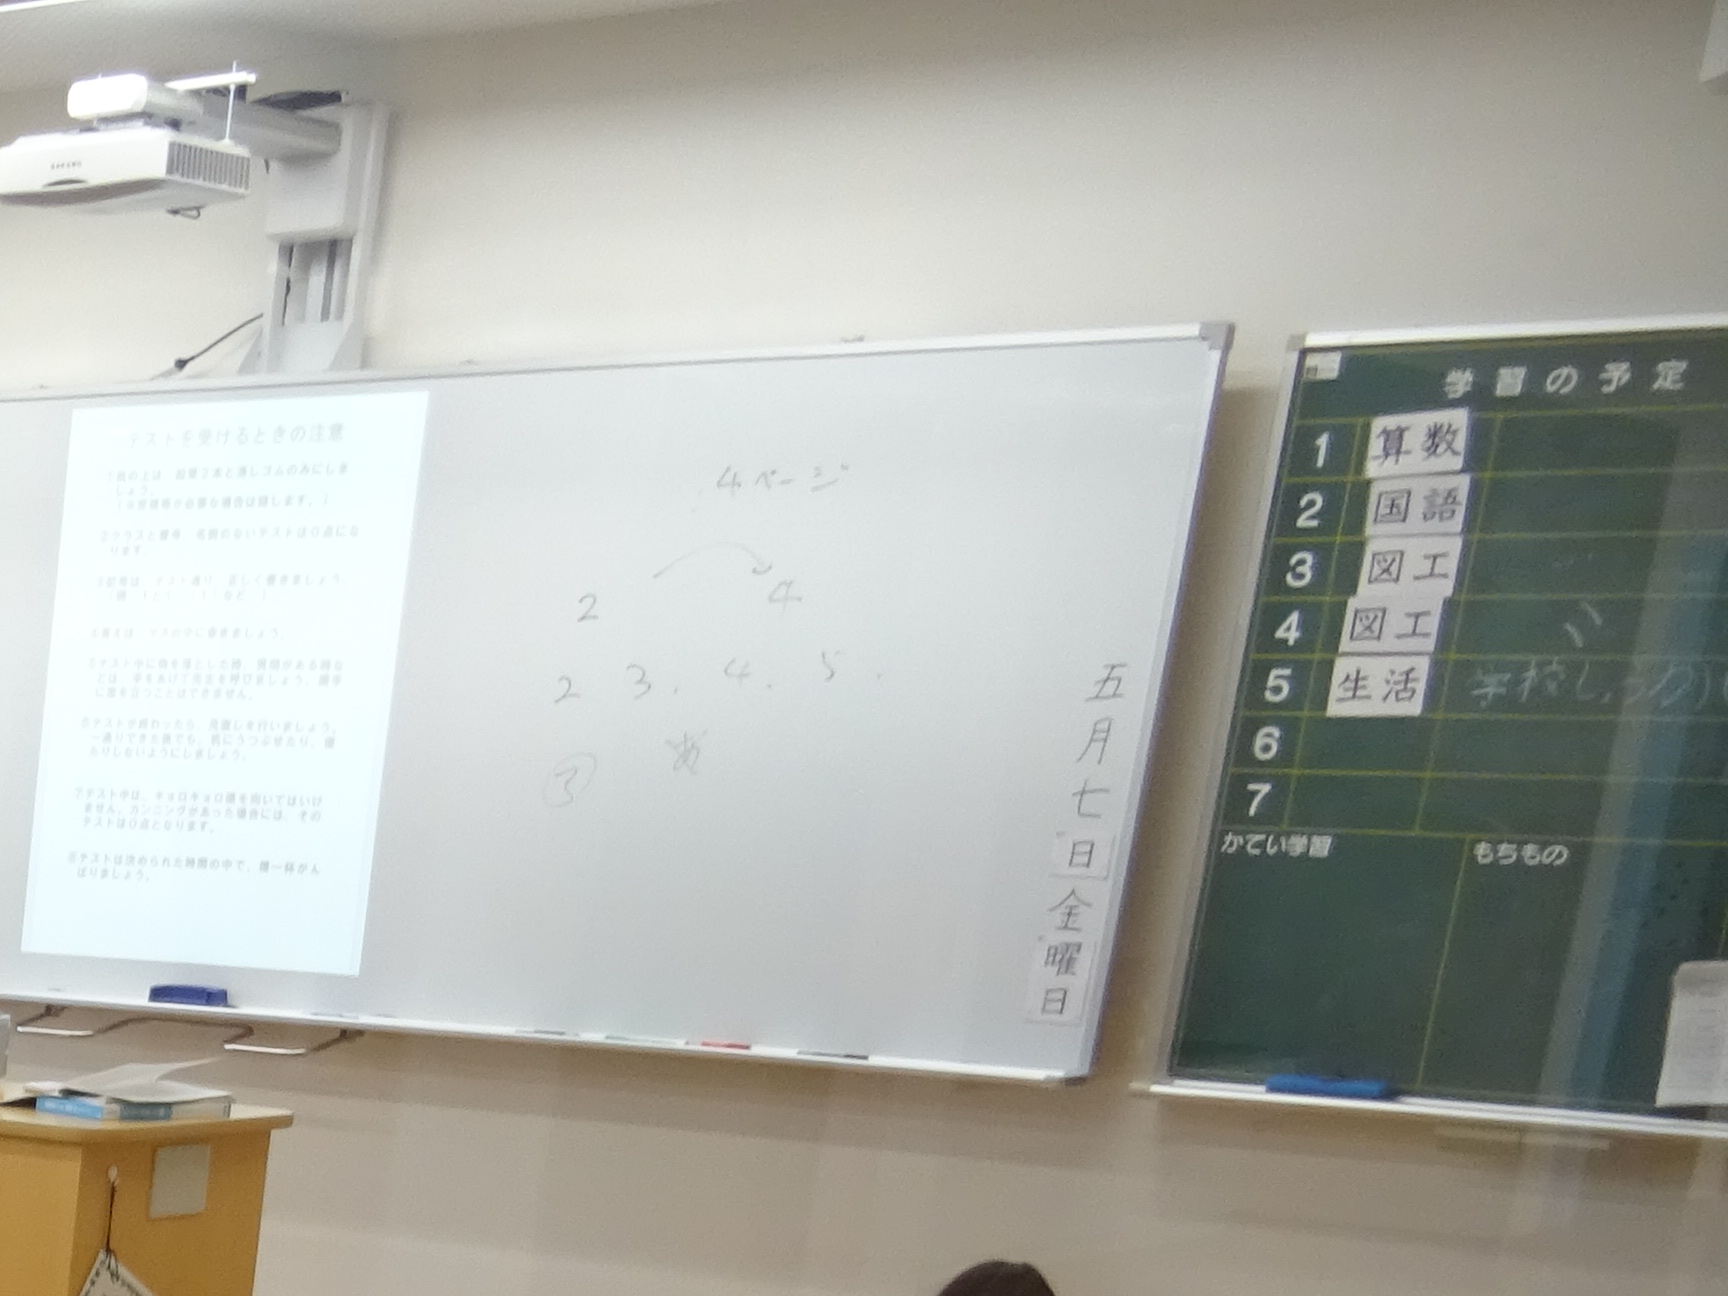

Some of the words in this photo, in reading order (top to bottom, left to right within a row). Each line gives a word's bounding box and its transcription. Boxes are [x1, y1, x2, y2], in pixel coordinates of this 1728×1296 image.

[1443, 360, 1690, 398] 学習の予定
[1312, 431, 1331, 467] 1
[1371, 419, 1462, 466] 算数
[1296, 493, 1324, 528] 2
[1373, 486, 1463, 526] 国語
[1285, 552, 1314, 588] 3
[1367, 546, 1450, 586] 図工
[577, 593, 599, 623] 2
[768, 579, 803, 613] 4
[1274, 611, 1302, 645] 4
[1349, 605, 1431, 643] 図工
[554, 675, 581, 704] 2
[1263, 667, 1293, 704] 5
[1336, 666, 1420, 705] 生活
[1252, 726, 1282, 761] 6
[1246, 783, 1272, 817] 7
[1221, 832, 1333, 859] かてい学習
[1473, 840, 1568, 868] もちもの
